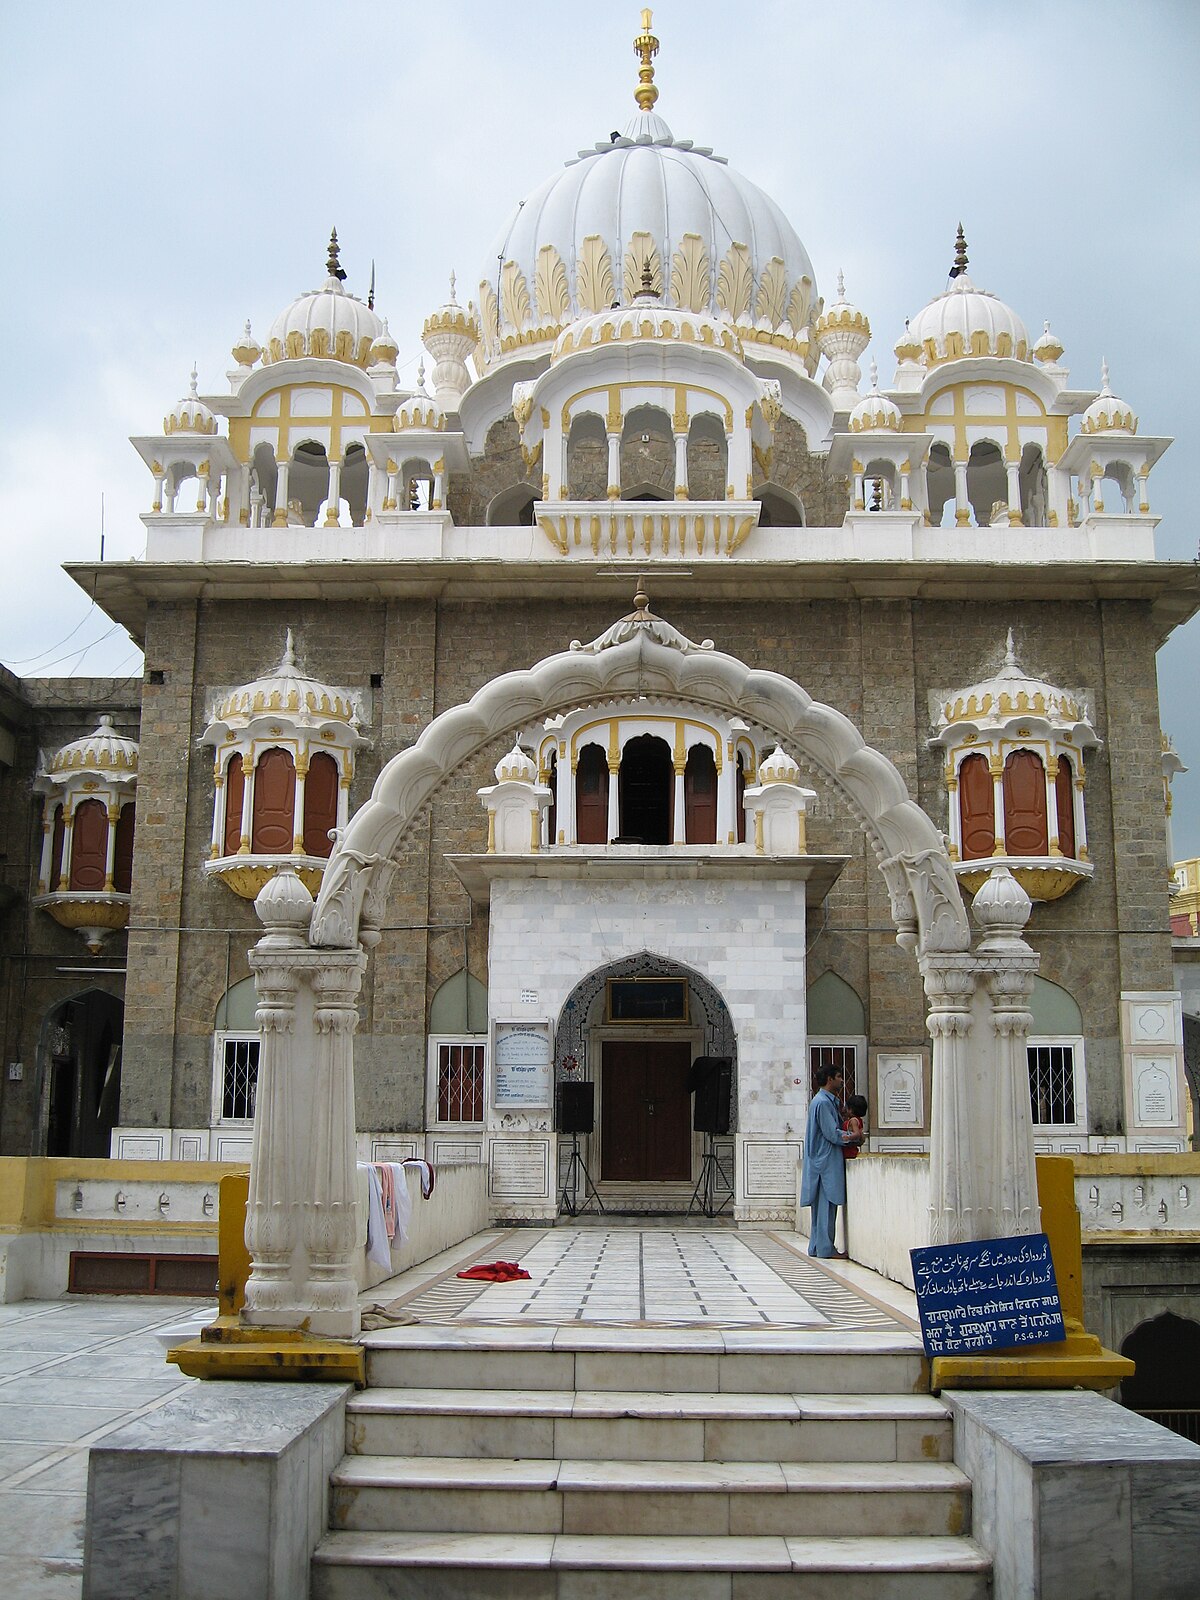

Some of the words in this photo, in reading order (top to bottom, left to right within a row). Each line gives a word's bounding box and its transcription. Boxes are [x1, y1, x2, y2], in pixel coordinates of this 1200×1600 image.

[991, 1252, 1003, 1267] میں
[1003, 1256, 1018, 1266] حدود
[1018, 1245, 1027, 1263] کی
[941, 1256, 957, 1273] سخت
[967, 1255, 979, 1273] سر
[957, 1277, 968, 1293] ہاتھ
[988, 1273, 1004, 1289] جانے
[1003, 1273, 1016, 1287] اندر
[1016, 1269, 1027, 1286] کے
[917, 1278, 933, 1298] کریں
